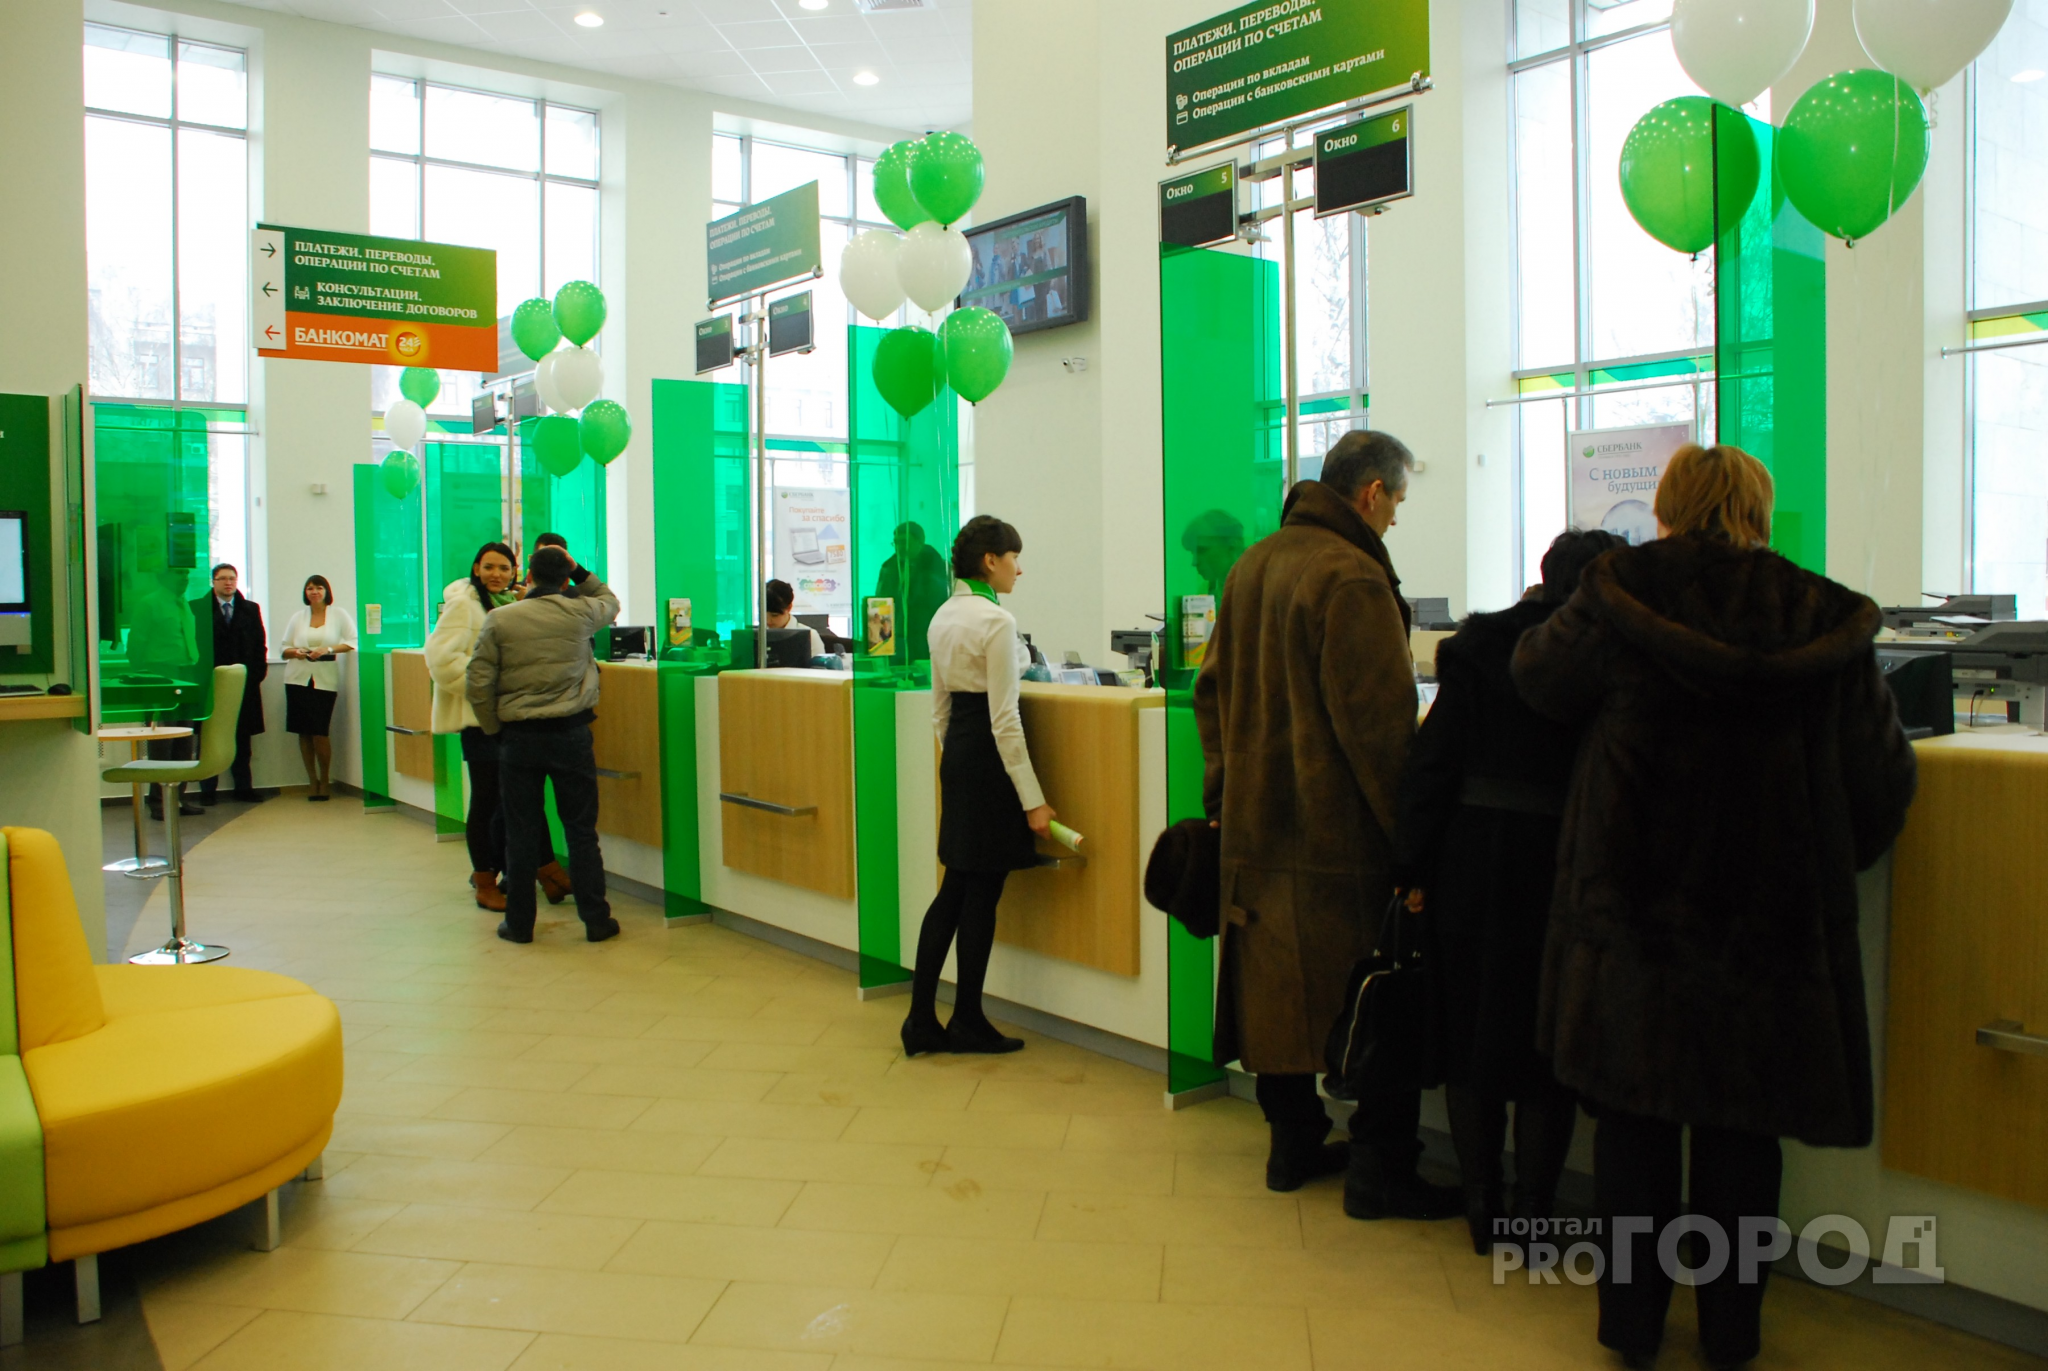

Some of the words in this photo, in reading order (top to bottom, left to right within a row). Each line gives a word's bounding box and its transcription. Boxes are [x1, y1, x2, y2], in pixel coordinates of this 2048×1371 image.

[1173, 19, 1237, 56] ПЛАТЕЖИ.
[1174, 40, 1242, 73] ОПЕРАЦИИ
[1244, 32, 1263, 46] ПО
[1266, 9, 1322, 39] СЧЕТАМ
[1193, 77, 1245, 103] Операции
[1247, 71, 1260, 83] по
[1263, 55, 1310, 78] вкладам
[1193, 94, 1245, 119] Операции
[1247, 92, 1253, 102] с
[1254, 68, 1330, 100] банковскими
[1333, 49, 1384, 76] картами
[1392, 119, 1400, 132] 6
[1324, 134, 1357, 152] Окно
[1221, 173, 1227, 184] 5
[1166, 184, 1193, 200] Окно
[741, 228, 750, 238] ПО
[751, 218, 775, 234] СЧЕТАМ
[295, 241, 362, 258] ПЛАТЕЖИ.
[365, 249, 436, 266] ПЕРЕВОДЫ.
[295, 256, 366, 271] ОПЕРАЦИИ
[370, 262, 388, 274] ПО
[391, 265, 440, 279] СЧЕТАМ
[317, 283, 422, 301] КОНСУЛЬТАЦИИ.
[317, 296, 403, 313] ЗАКЛЮЧЕНИЕ
[406, 303, 477, 319] ДОГОВОРОВ
[295, 327, 389, 348] БАНКОМАТ
[399, 336, 414, 346] 24
[1597, 442, 1642, 453] СБЕРБАНК
[1589, 468, 1599, 480] С
[1608, 481, 1660, 494] будущи
[812, 514, 845, 522] спасибо
